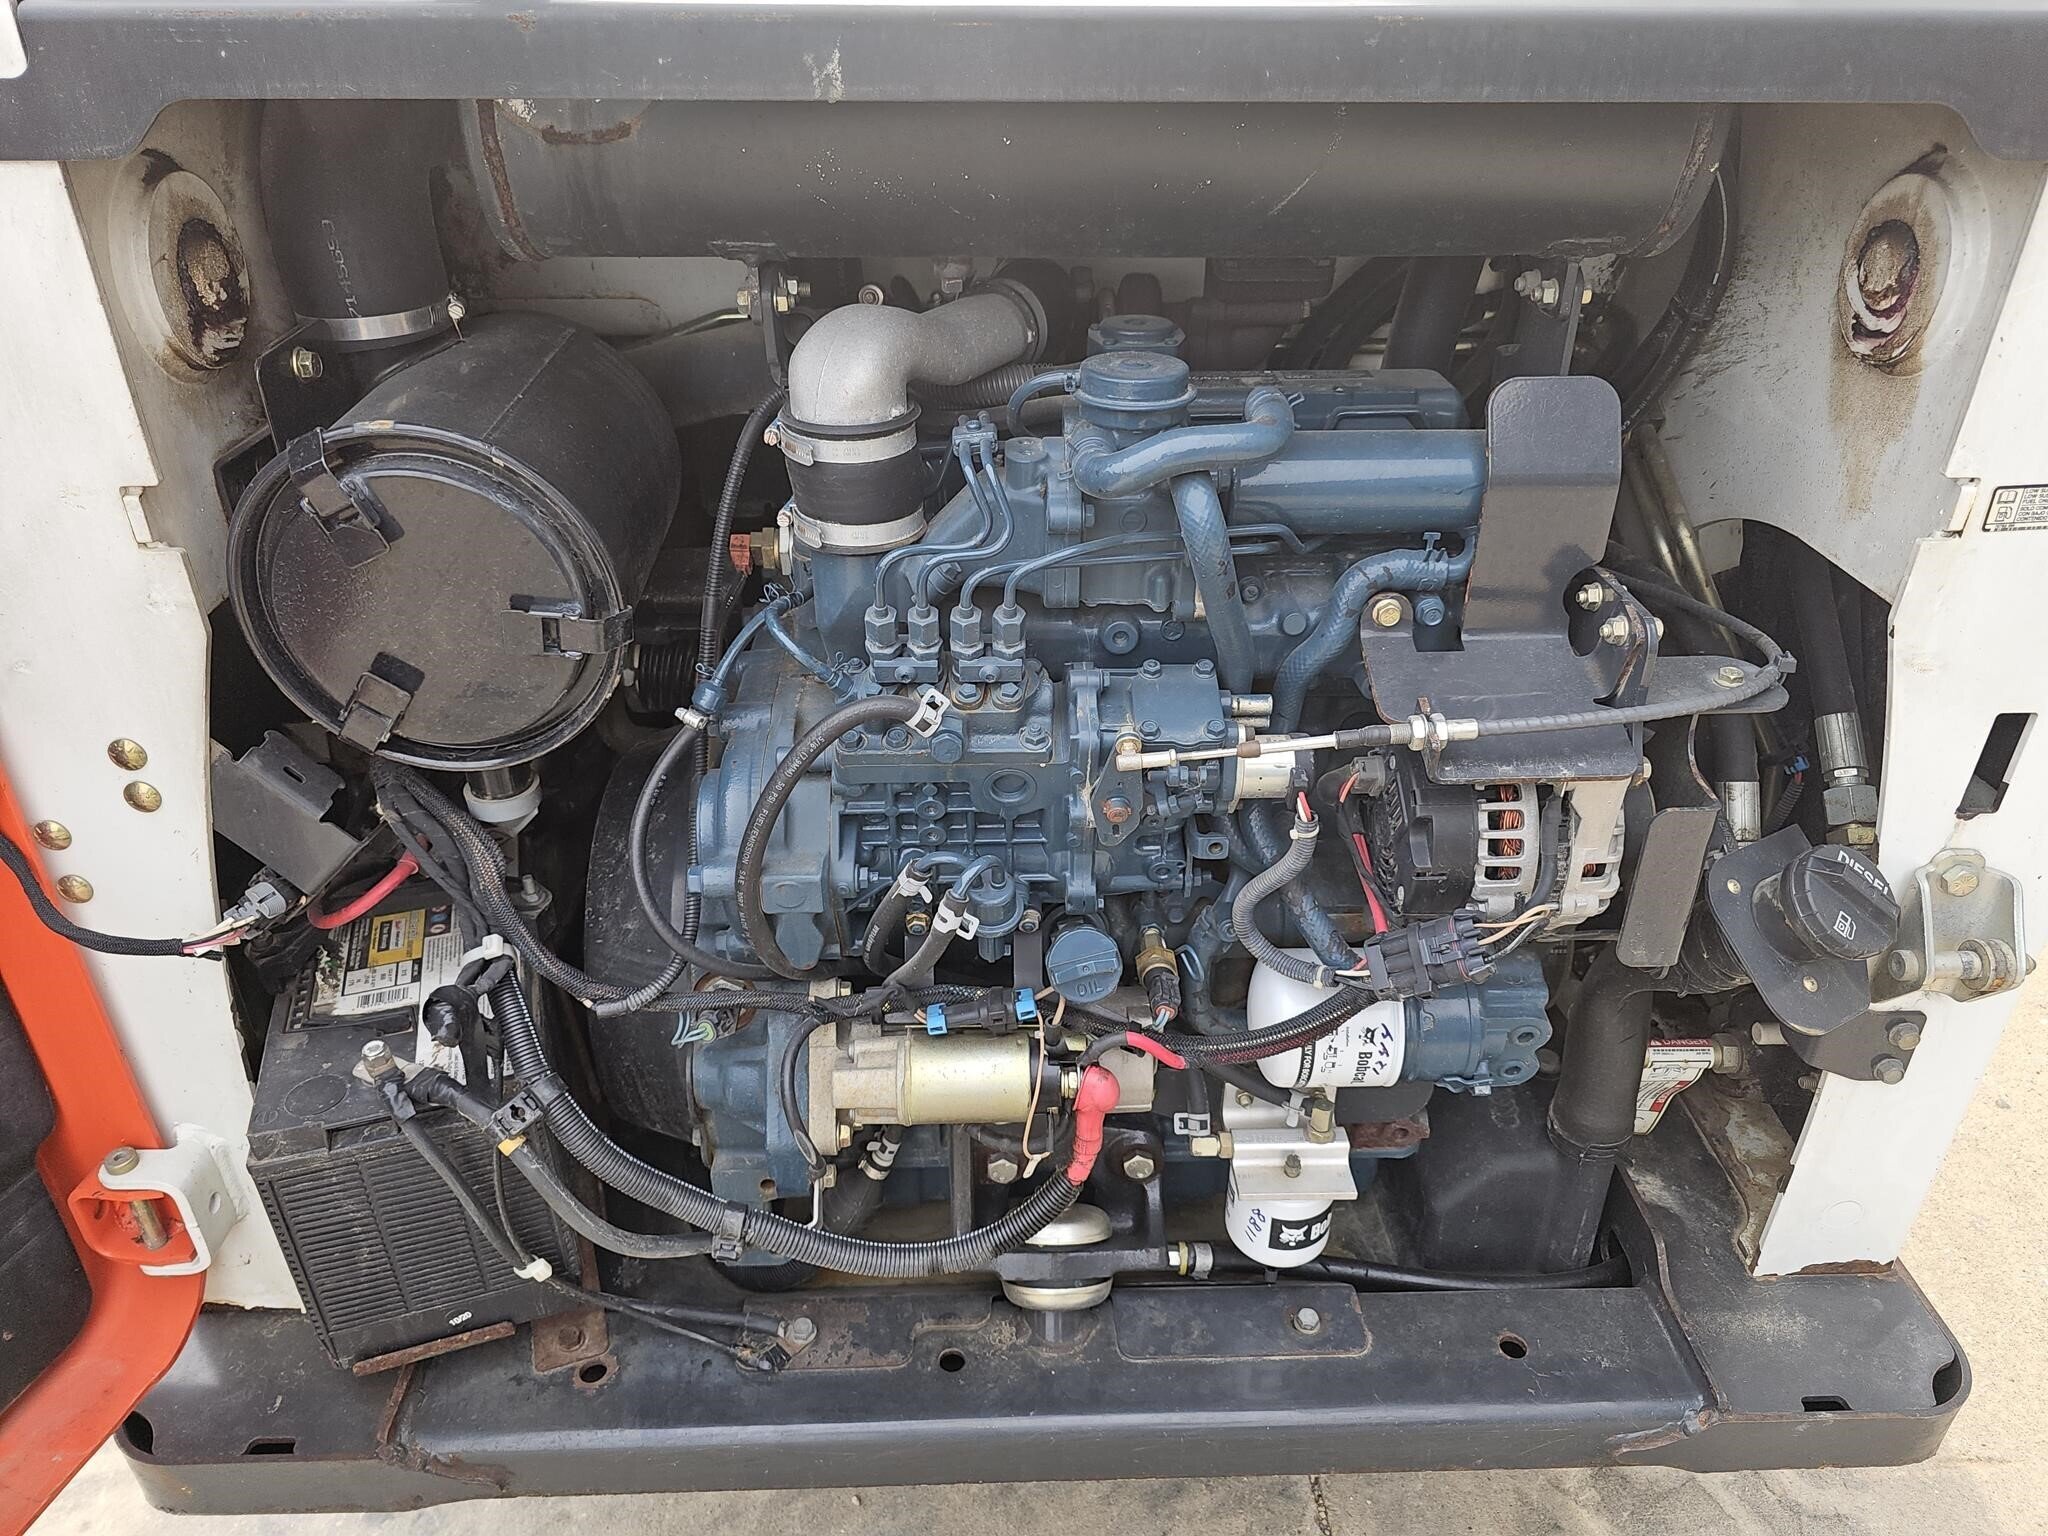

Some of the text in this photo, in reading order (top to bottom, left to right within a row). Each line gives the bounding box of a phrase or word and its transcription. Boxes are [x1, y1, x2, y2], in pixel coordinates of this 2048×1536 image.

[810, 735, 825, 753] 5/16"
[784, 751, 808, 778] (7.9MM)
[775, 781, 785, 791] 50
[767, 792, 779, 805] PSI
[742, 808, 769, 865] FUEL/EMISSION
[738, 870, 746, 886] SAE
[1076, 979, 1105, 997] OIL
[1662, 1038, 1709, 1046] DANGER
[1302, 1056, 1312, 1069] FOR
[1350, 1051, 1373, 1085] Bobcat
[1245, 1208, 1266, 1243] 1188
[449, 1311, 472, 1326] 10/20
